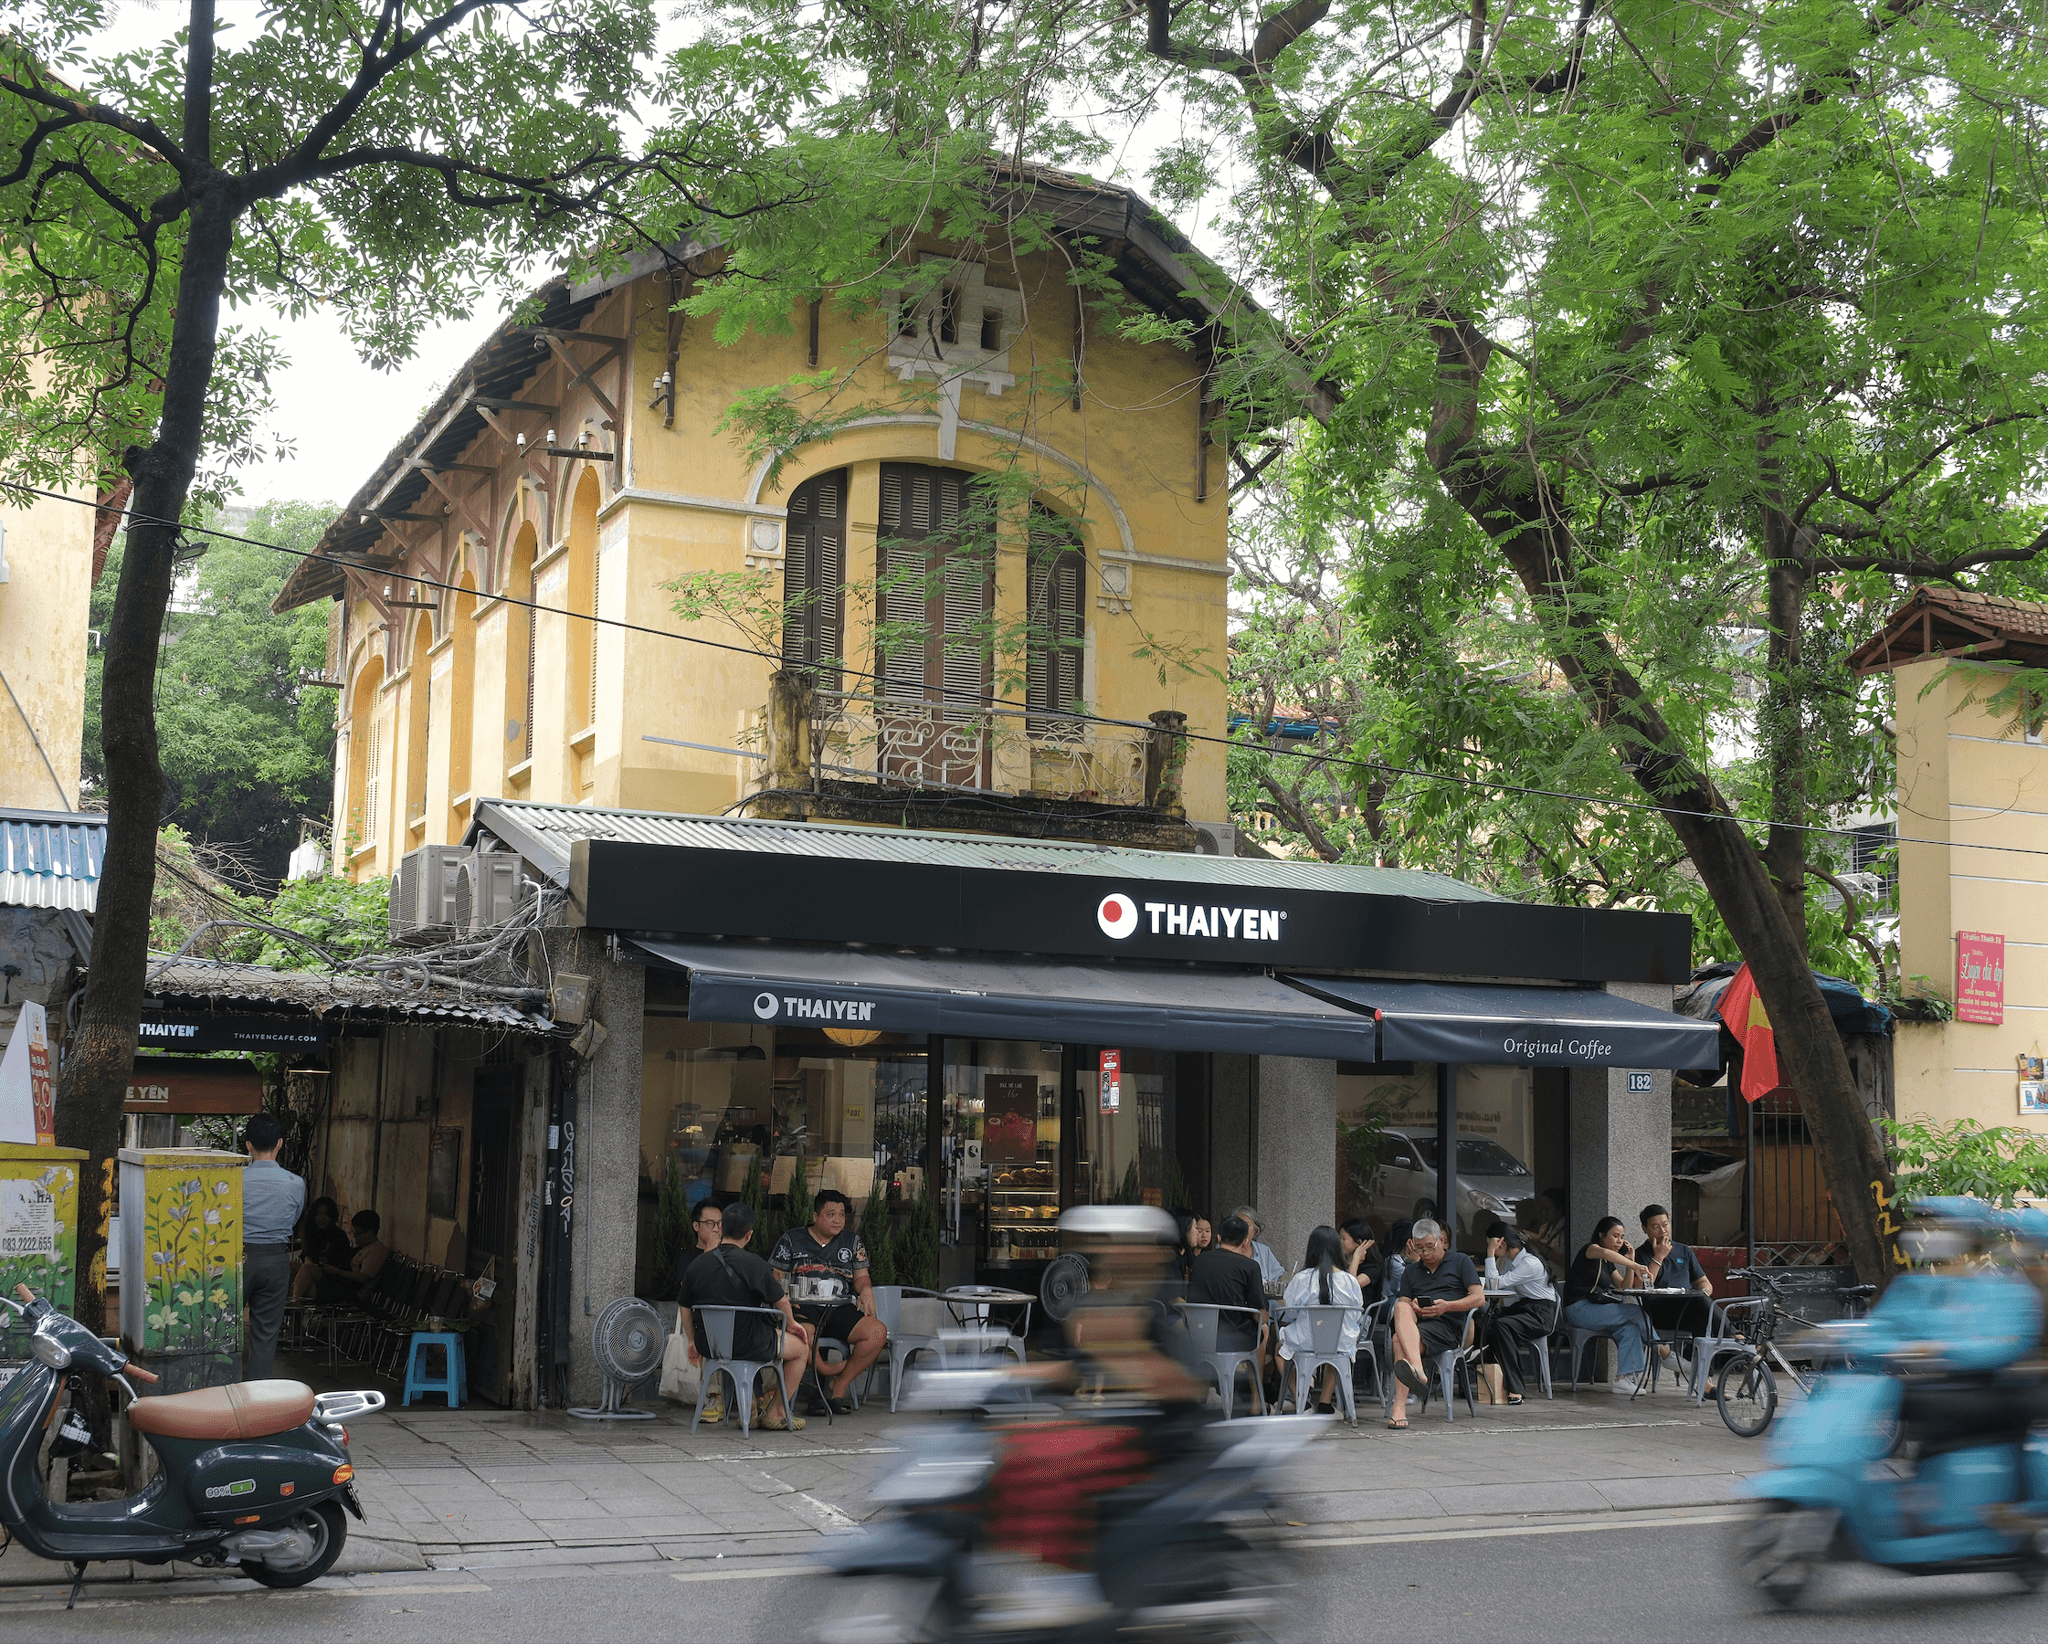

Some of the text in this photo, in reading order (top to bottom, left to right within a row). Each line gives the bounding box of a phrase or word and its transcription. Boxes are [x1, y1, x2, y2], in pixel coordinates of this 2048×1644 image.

[234, 1032, 317, 1042] THAIYENCAFE.COM
[1503, 1038, 1612, 1060] Original Coffee
[1630, 1074, 1651, 1090] 182
[138, 1084, 169, 1100] YÊN
[206, 1485, 230, 1498] 99%
